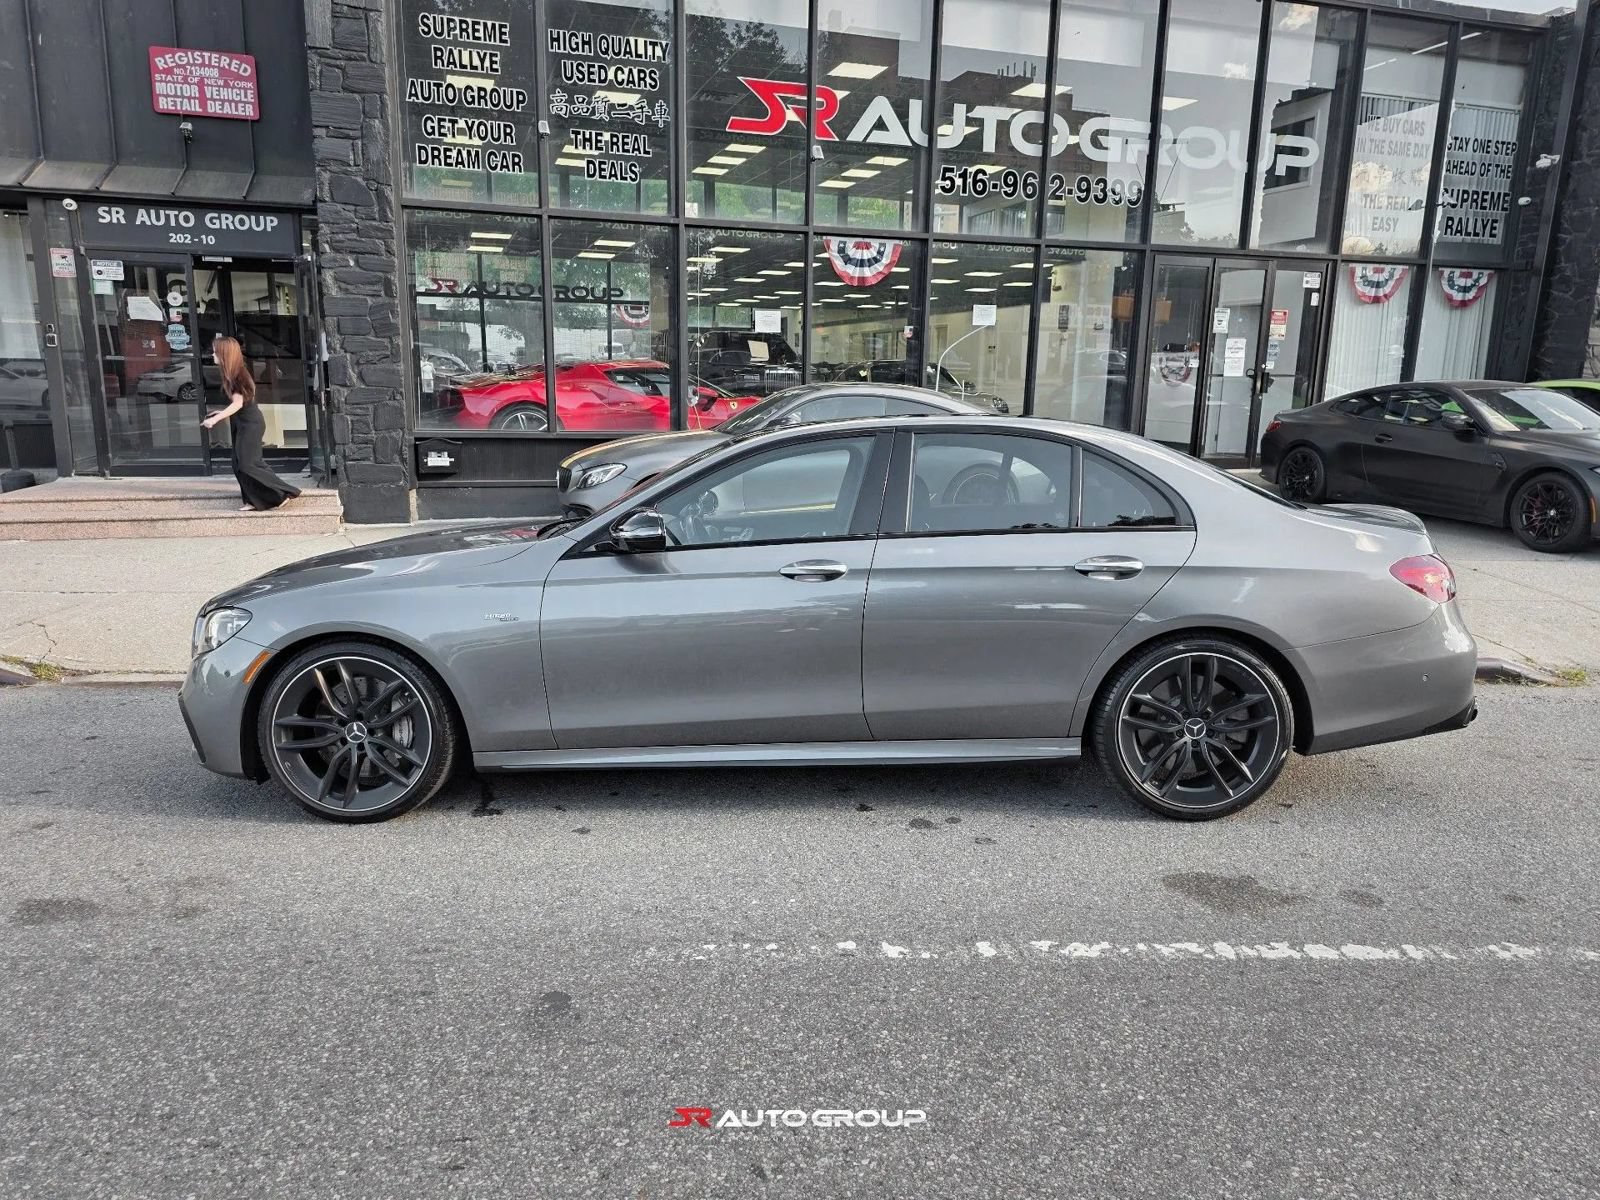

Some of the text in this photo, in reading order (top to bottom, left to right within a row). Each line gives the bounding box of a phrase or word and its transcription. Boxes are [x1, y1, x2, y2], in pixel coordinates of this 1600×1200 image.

[419, 12, 510, 46] SUPREME
[432, 45, 500, 73] RALLYE
[548, 29, 671, 63] HIGH QUALITY
[154, 51, 251, 77] REGISTERED
[562, 60, 659, 91] USED CARS
[155, 73, 253, 88] STATE OF NEW YORK
[155, 82, 254, 102] MOTOR VEHICLE
[158, 96, 253, 116] RETAIL DEALER
[406, 78, 527, 111] AUTO GROUP
[549, 89, 671, 128] 高品質二手車
[725, 76, 839, 142] SR
[421, 115, 515, 145] GET YOUR
[1382, 117, 1402, 134] BUY
[1403, 119, 1426, 136] CARS
[570, 129, 652, 157] THE REAL
[1356, 137, 1431, 159] IN THE SAME DAY
[1472, 137, 1492, 154] ONE
[1494, 140, 1518, 156] STEP
[416, 144, 524, 174] DREAM CAR
[585, 158, 640, 183] DEALS
[1445, 160, 1477, 176] AHEAD
[1479, 162, 1492, 178] OF
[1494, 163, 1513, 179] THE
[1363, 193, 1383, 210] THE
[97, 205, 279, 232] SR AUTO GROUP
[1371, 216, 1399, 232] EASY
[1443, 216, 1499, 239] RALLYE
